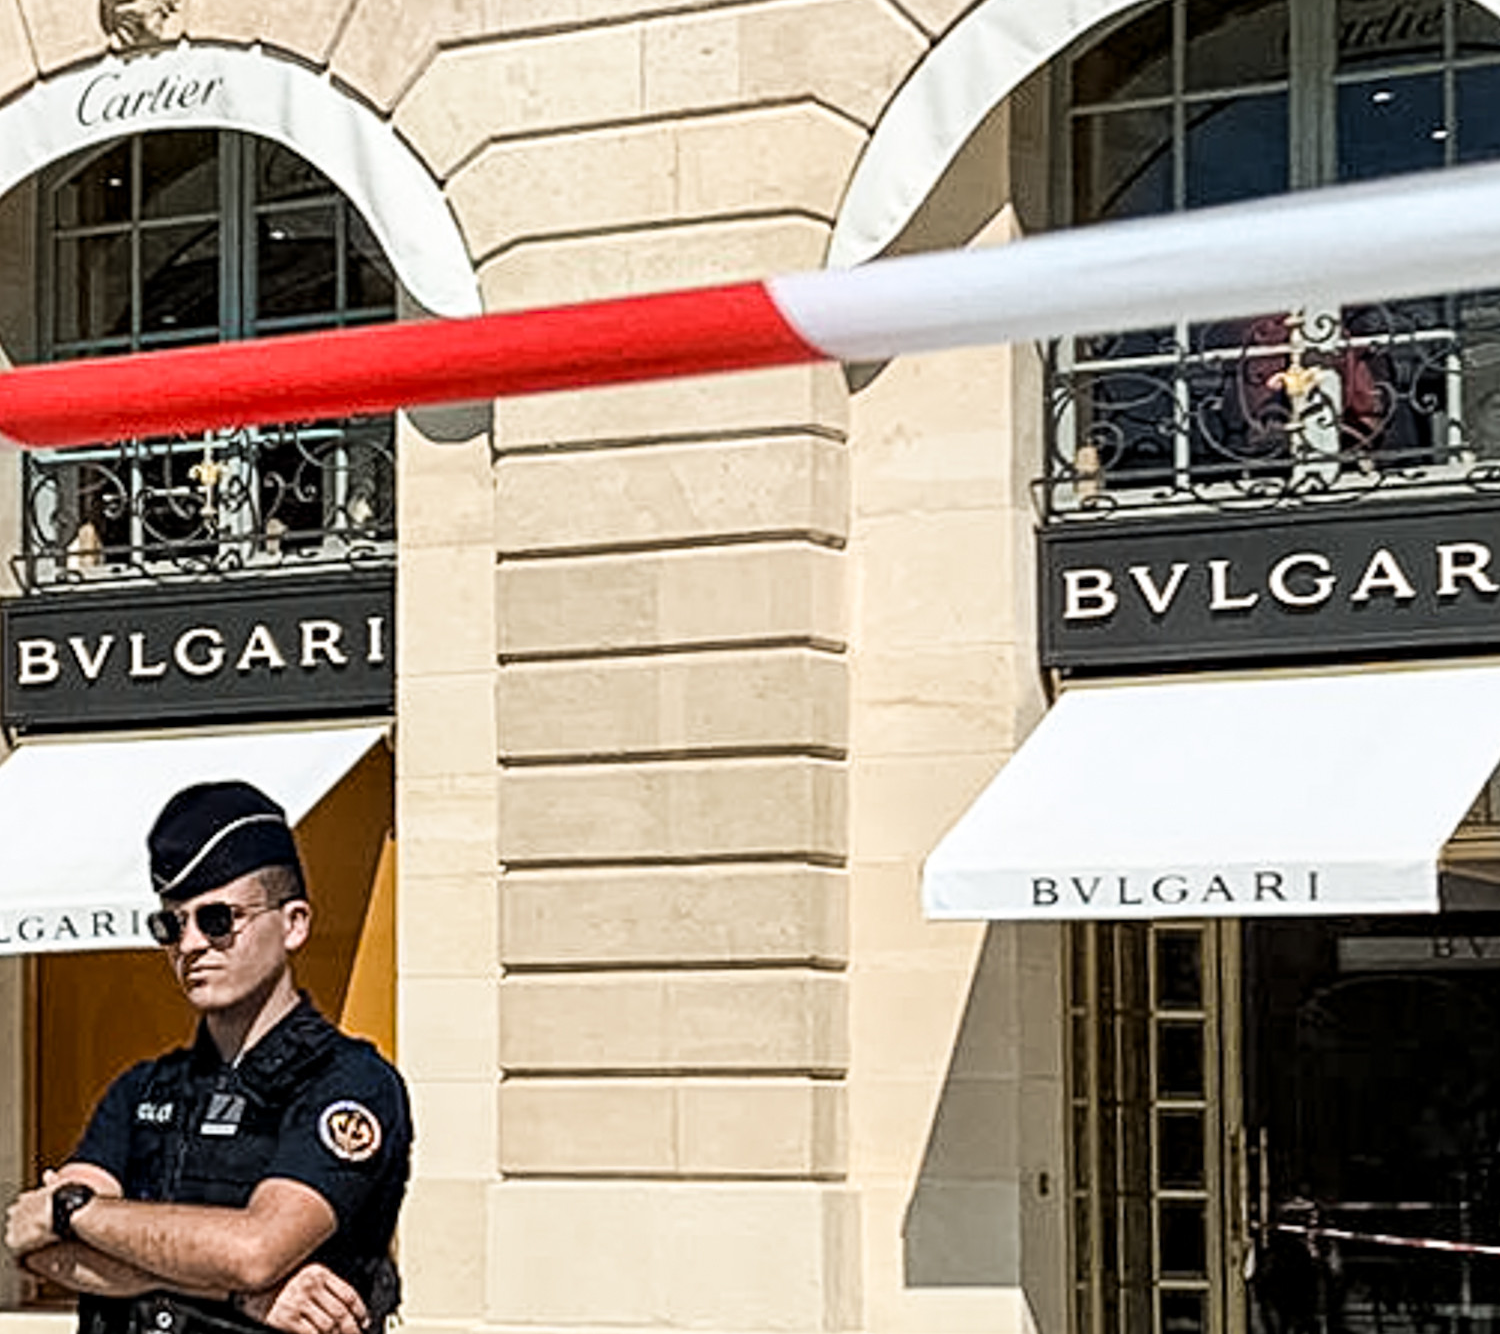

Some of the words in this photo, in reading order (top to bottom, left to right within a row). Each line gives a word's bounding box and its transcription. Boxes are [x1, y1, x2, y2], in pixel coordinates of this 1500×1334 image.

[76, 72, 225, 128] Cartier
[17, 616, 385, 684] BVLGARI
[1031, 871, 1320, 906] BVLGARI
